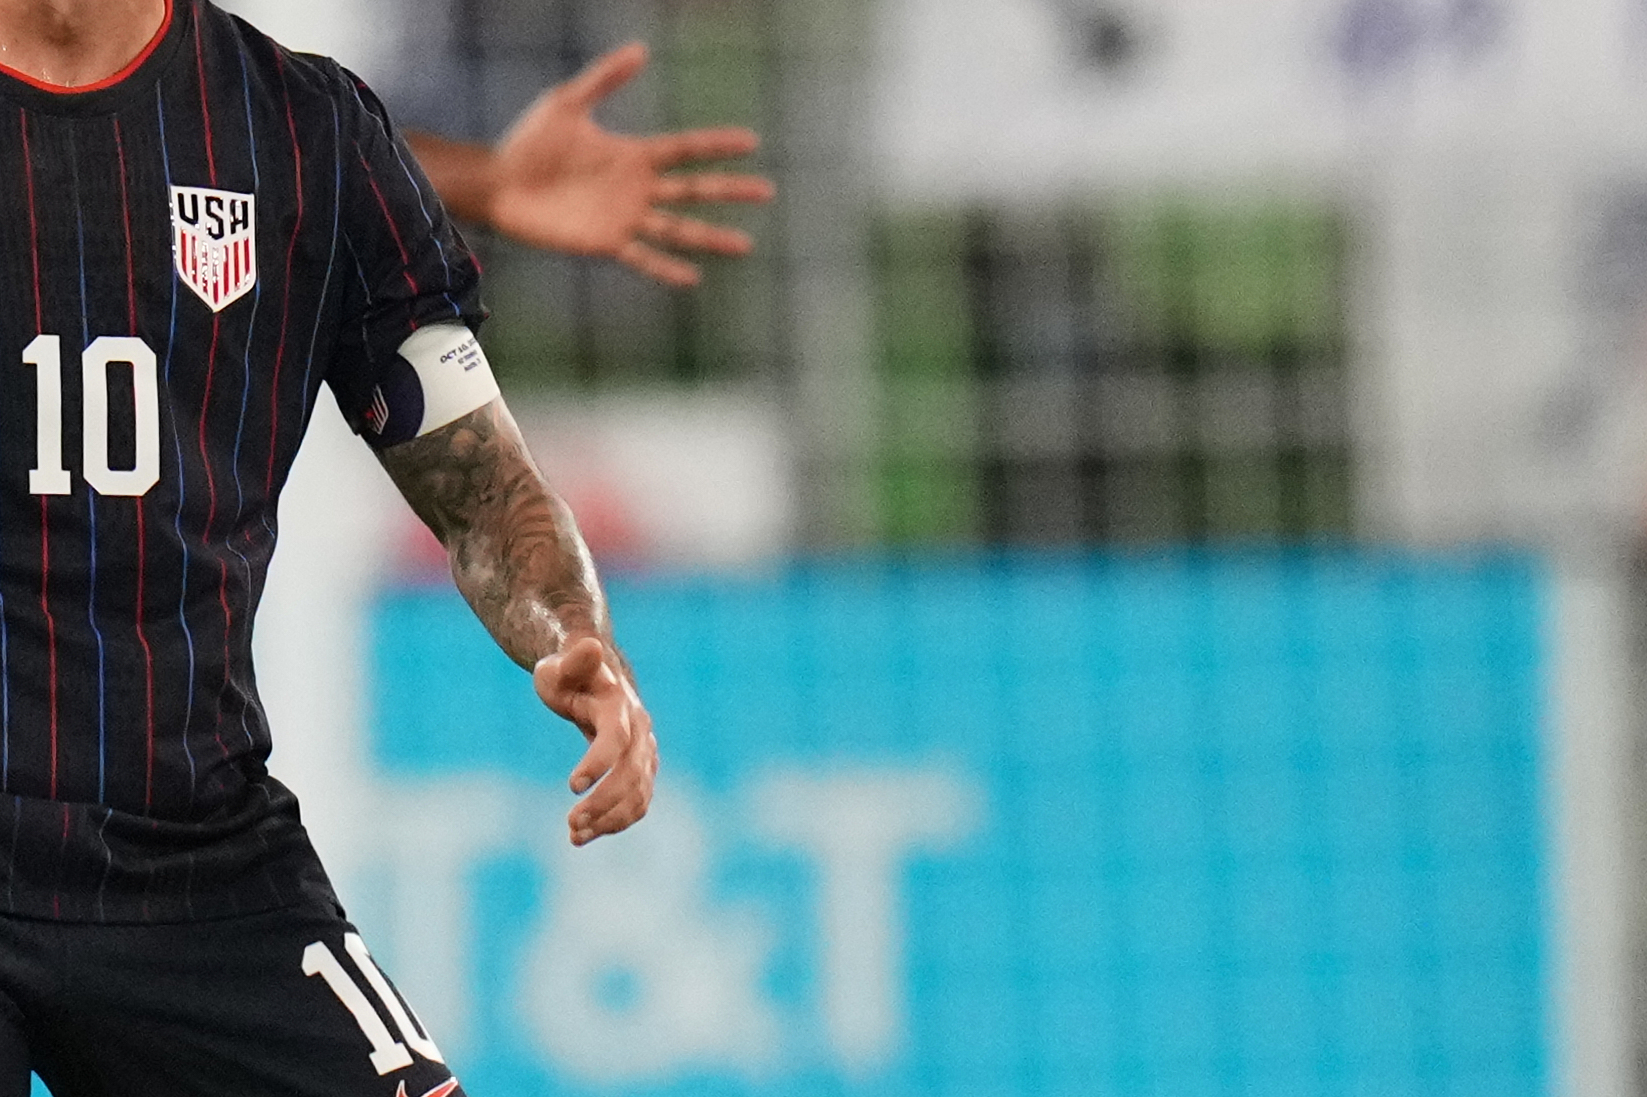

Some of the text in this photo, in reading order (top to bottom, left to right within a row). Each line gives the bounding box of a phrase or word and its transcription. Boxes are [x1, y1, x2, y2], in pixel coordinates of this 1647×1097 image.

[177, 192, 249, 240] USA
[440, 348, 457, 364] OCT
[22, 334, 160, 496] 10
